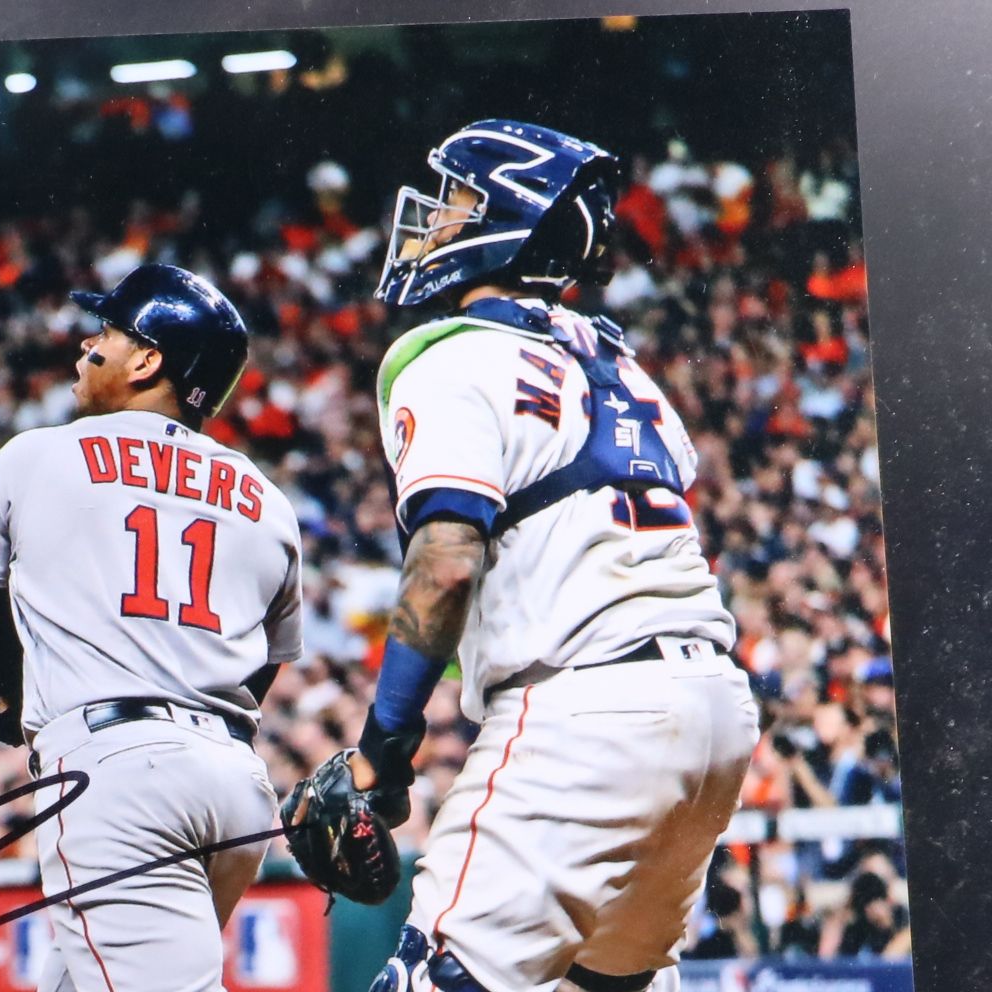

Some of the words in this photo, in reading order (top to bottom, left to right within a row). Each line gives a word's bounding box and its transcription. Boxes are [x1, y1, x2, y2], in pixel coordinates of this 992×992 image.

[186, 387, 207, 407] 11
[79, 436, 264, 522] DEVERS
[120, 504, 222, 635] 11
